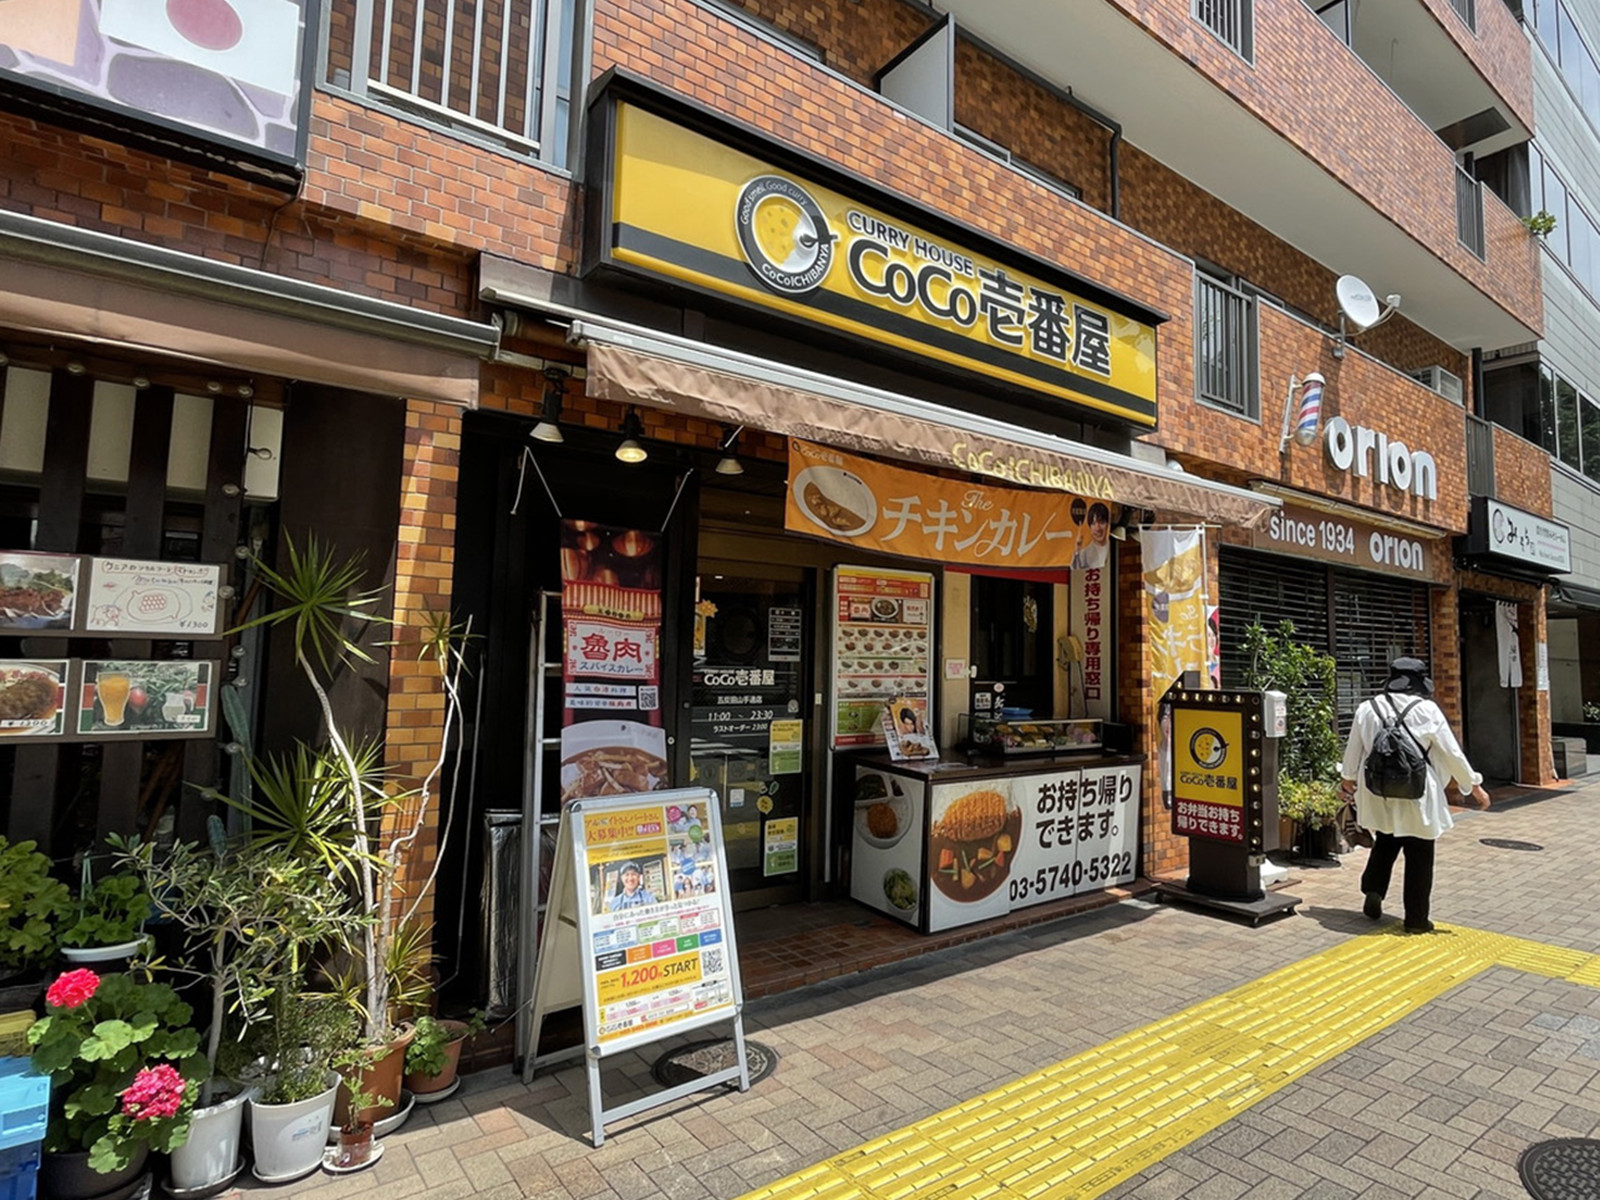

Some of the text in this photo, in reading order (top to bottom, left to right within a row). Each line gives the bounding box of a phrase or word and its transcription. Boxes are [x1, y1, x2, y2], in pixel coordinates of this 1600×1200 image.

[740, 197, 752, 225] Good
[765, 180, 788, 193] Good
[788, 188, 808, 206] curry
[848, 212, 974, 276] CURRY HOUSE
[762, 243, 829, 287] CoCoICHIBANYA
[849, 238, 1111, 377] CoCo壱番屋
[961, 490, 994, 511] The
[880, 495, 1073, 558] チキンカレー
[1269, 511, 1424, 571] since 1934 orion
[1084, 568, 1101, 701] お持ち帰り専用窓口
[579, 661, 643, 673] スパイスカレー
[704, 669, 775, 686] CoCo壱番屋
[708, 711, 731, 721] 11:00
[750, 709, 774, 720] 23:30
[713, 723, 751, 733] ラストオーダー
[752, 723, 768, 731] 23:00
[1037, 774, 1133, 814] お持ち帰り
[1180, 774, 1238, 790] CoCo壱番屋
[1035, 809, 1119, 849] できます。
[1177, 802, 1241, 823] お弁当お持ち
[1177, 816, 1244, 840] 帰りできます。
[1009, 851, 1131, 902] 03-5740-5322
[663, 958, 699, 977] START
